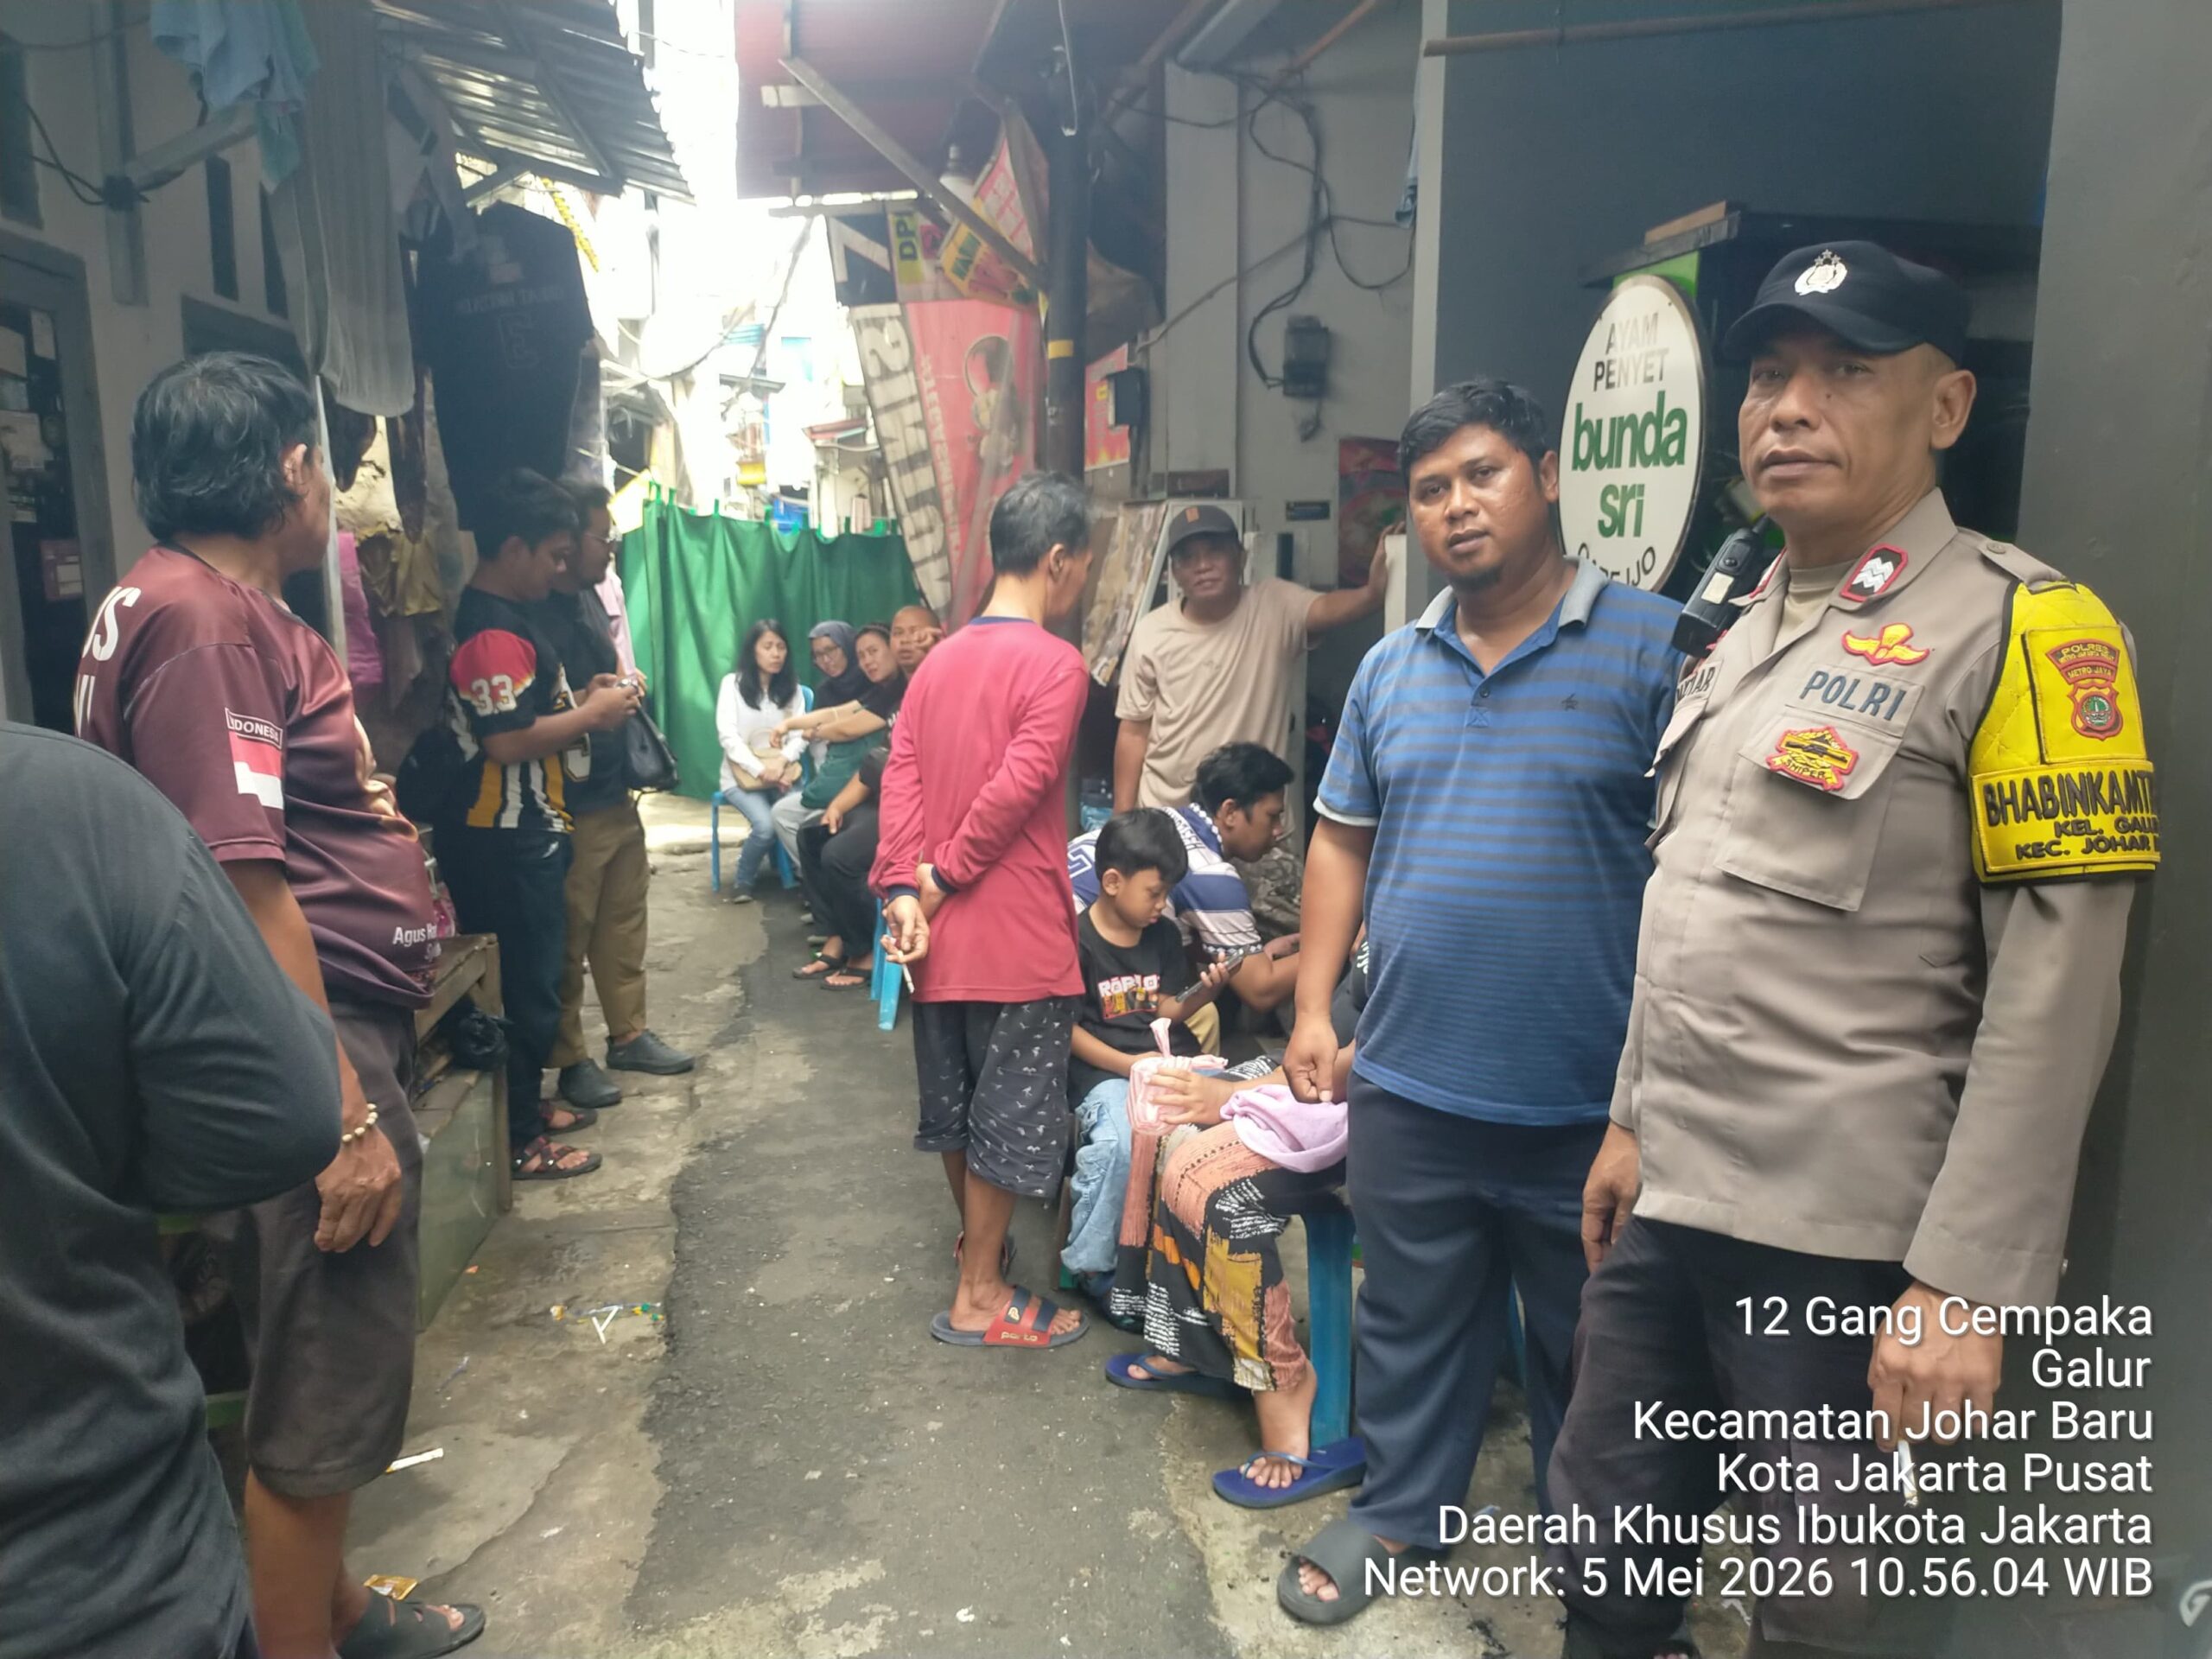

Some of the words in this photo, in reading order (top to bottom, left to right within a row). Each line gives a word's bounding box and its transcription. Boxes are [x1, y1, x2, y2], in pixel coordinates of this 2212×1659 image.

[1605, 312, 1659, 355] AYAM
[1592, 349, 1669, 391] PENYET
[1572, 391, 1688, 471] bunda
[1599, 483, 1645, 538] sri
[82, 586, 141, 662] S
[2061, 643, 2111, 657] POLRES
[2068, 666, 2092, 678] METRO
[2094, 666, 2112, 676] JAYA
[472, 674, 517, 717] 33
[1799, 671, 1907, 721] POLRI
[1784, 758, 1827, 779] SNIPER
[2016, 840, 2070, 860] KEC.
[2081, 835, 2150, 855] JOHAR
[2054, 819, 2104, 837] KEL.
[392, 926, 426, 947] Agus
